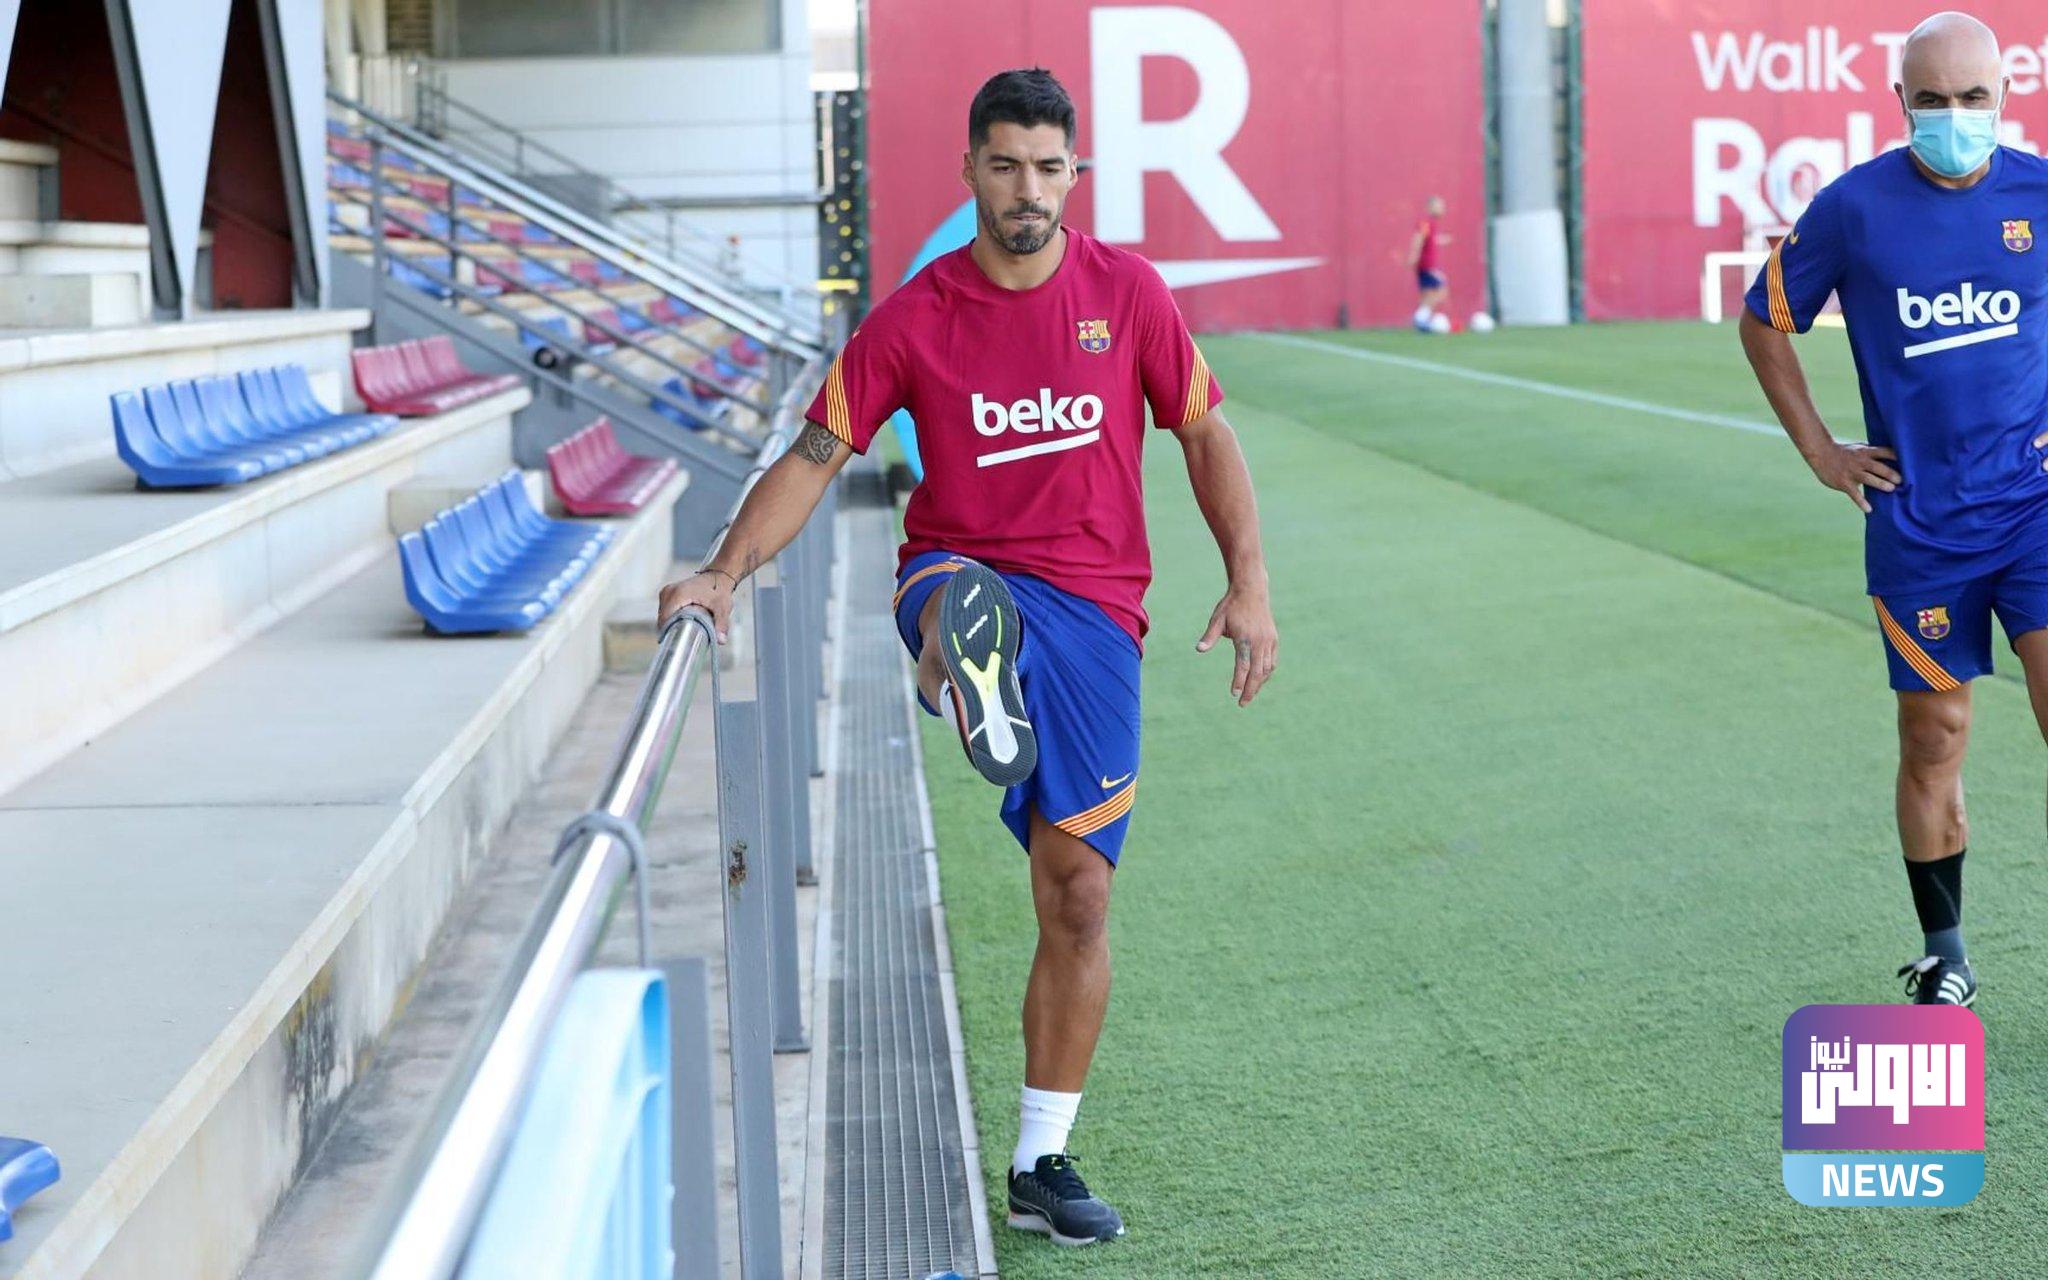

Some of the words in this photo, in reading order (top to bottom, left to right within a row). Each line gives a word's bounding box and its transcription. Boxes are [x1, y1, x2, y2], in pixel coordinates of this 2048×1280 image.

[1691, 26, 1864, 92] Walk
[1090, 7, 1282, 243] R
[1897, 283, 2021, 328] beko
[971, 388, 1103, 436] beko
